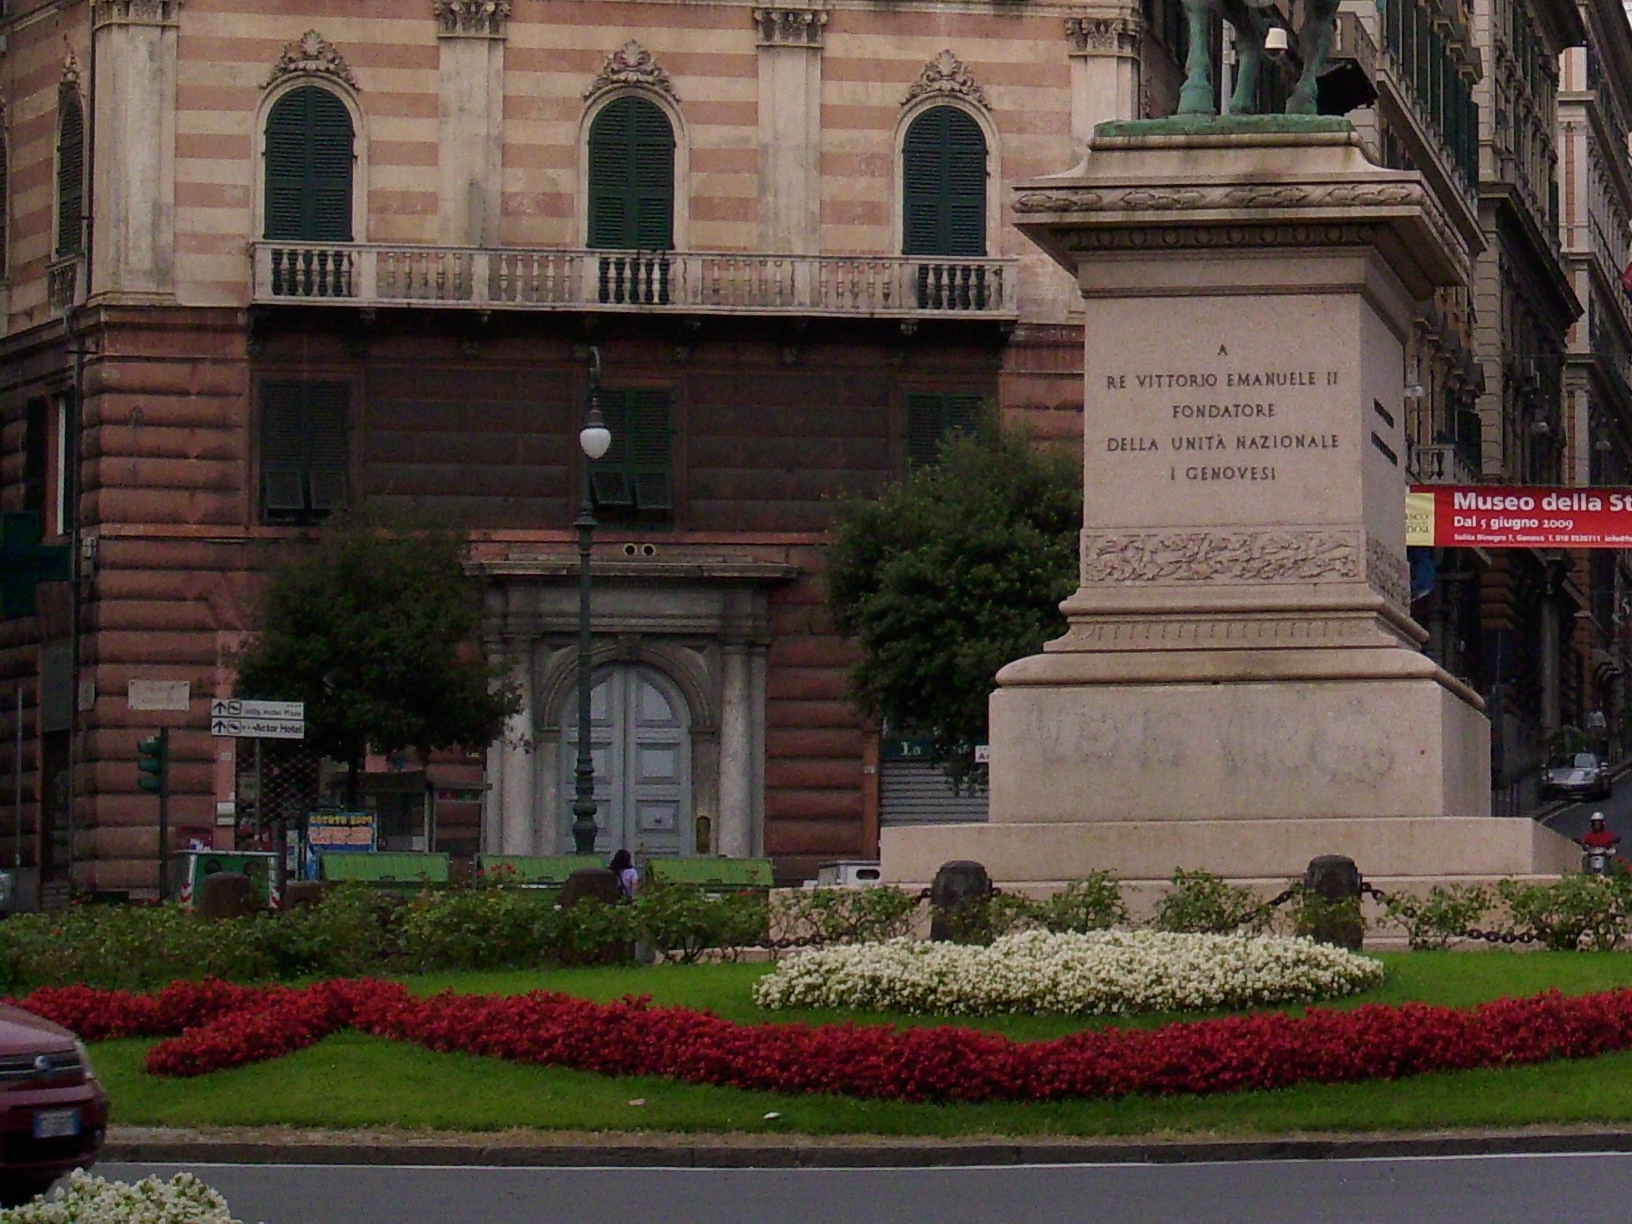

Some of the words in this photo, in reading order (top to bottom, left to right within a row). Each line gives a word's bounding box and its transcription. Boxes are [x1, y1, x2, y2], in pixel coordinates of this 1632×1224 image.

[1217, 343, 1229, 356] A
[1106, 374, 1127, 389] RE
[1135, 373, 1219, 388] VITTORIO
[1226, 371, 1316, 387] EMANUELE
[1326, 371, 1338, 385] II
[1172, 403, 1276, 419] FONDATORE
[1107, 437, 1160, 451] DELLA
[1171, 433, 1227, 450] UNITÀ
[1236, 434, 1340, 450] NAZIONALE
[1170, 466, 1175, 481] I
[1185, 466, 1277, 481] GENOVESI
[1453, 491, 1535, 511] Museo
[1541, 492, 1602, 511] della
[1453, 516, 1477, 528] Dal
[1480, 519, 1486, 530] 5
[1490, 516, 1539, 530] giugno
[1542, 518, 1574, 530] 2009
